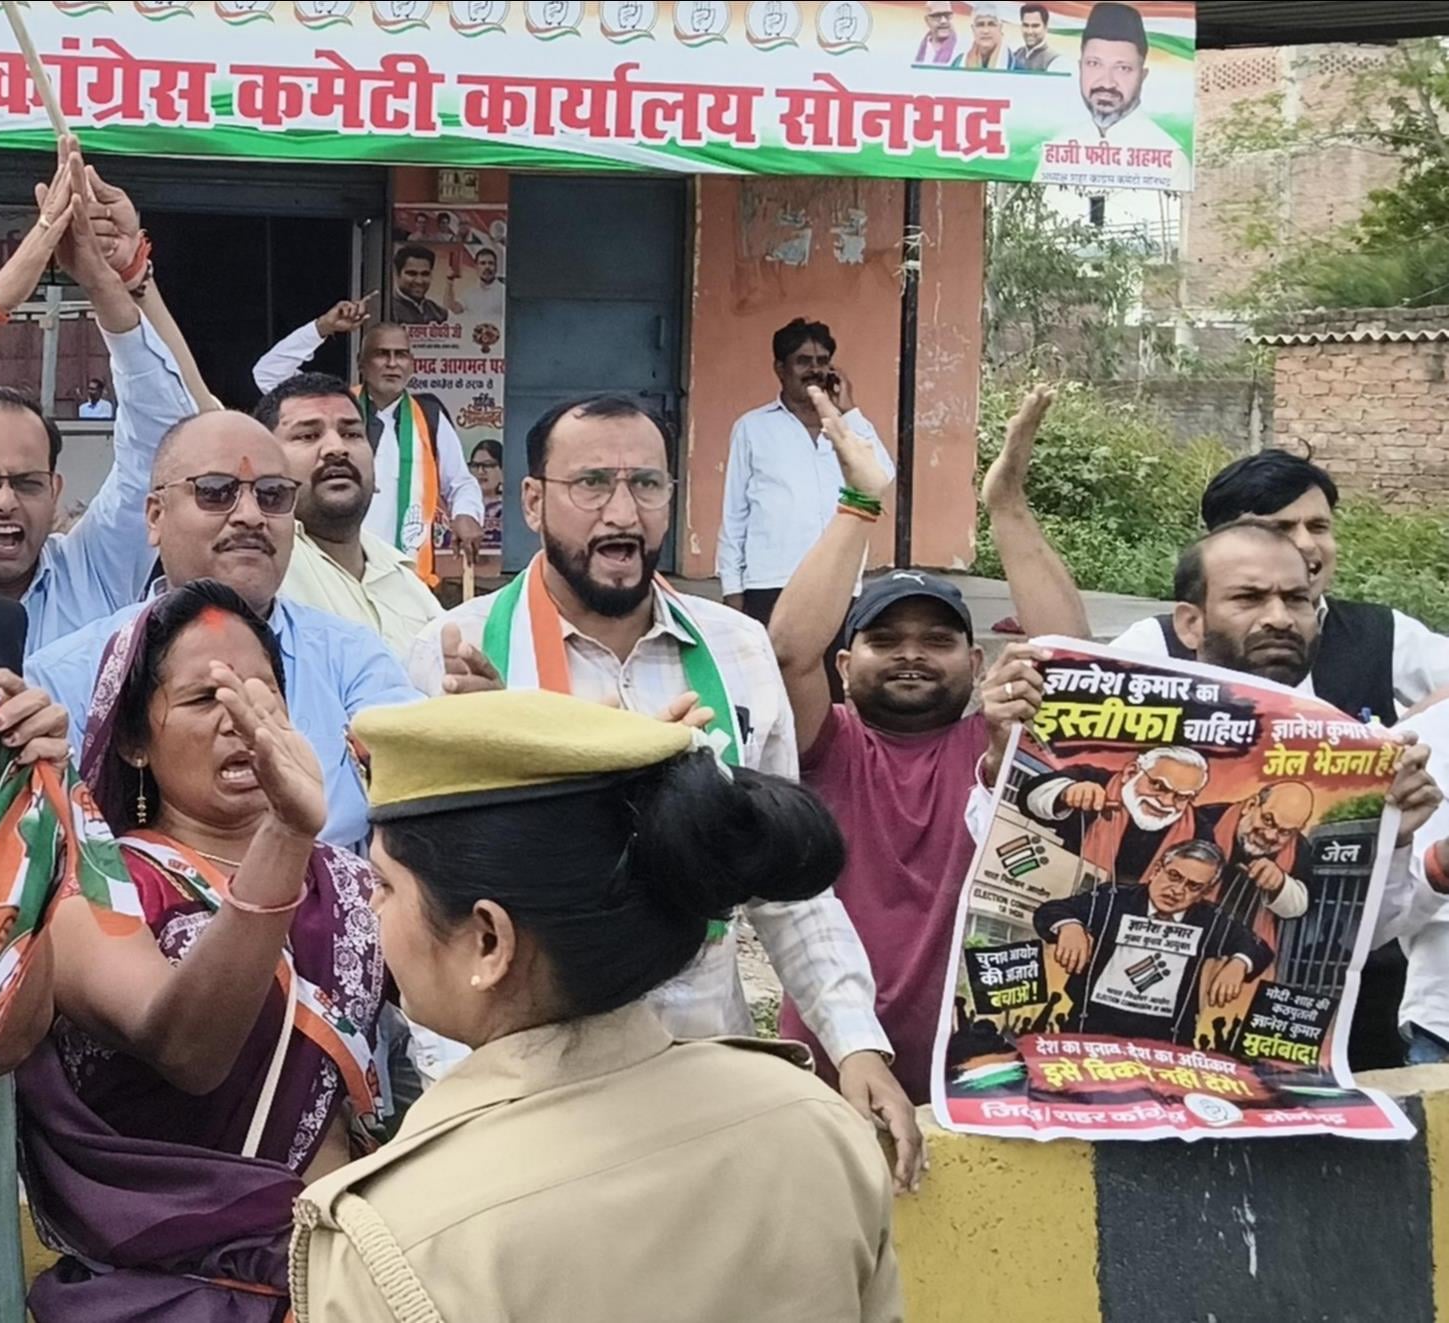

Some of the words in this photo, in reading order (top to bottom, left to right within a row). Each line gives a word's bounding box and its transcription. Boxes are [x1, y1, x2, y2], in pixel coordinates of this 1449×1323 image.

[229, 49, 446, 131] कमेटी
[456, 62, 764, 143] कार्यालय
[775, 72, 1011, 156] सोनभद्र
[1044, 139, 1081, 165] हाजी
[1084, 140, 1123, 166] फरीद
[1126, 147, 1173, 169] अहमद
[1043, 663, 1126, 697] ज्ञानेश
[1127, 673, 1194, 704] कुमार
[1195, 683, 1221, 703] का
[1033, 696, 1183, 743] इस्तीफा
[1270, 713, 1324, 742] ज्ञानेश
[1325, 719, 1370, 746] कुमार
[1262, 742, 1310, 776] जेल
[1312, 741, 1377, 776] भेजना
[1321, 840, 1362, 863] जेल
[979, 967, 1003, 985] की
[1250, 1013, 1289, 1032] ज्ञानेश
[1289, 1022, 1323, 1040] कुमार
[1035, 1036, 1059, 1055] देश
[1061, 1040, 1082, 1055] का
[1153, 1048, 1175, 1065] का
[1038, 1056, 1084, 1088] इसे
